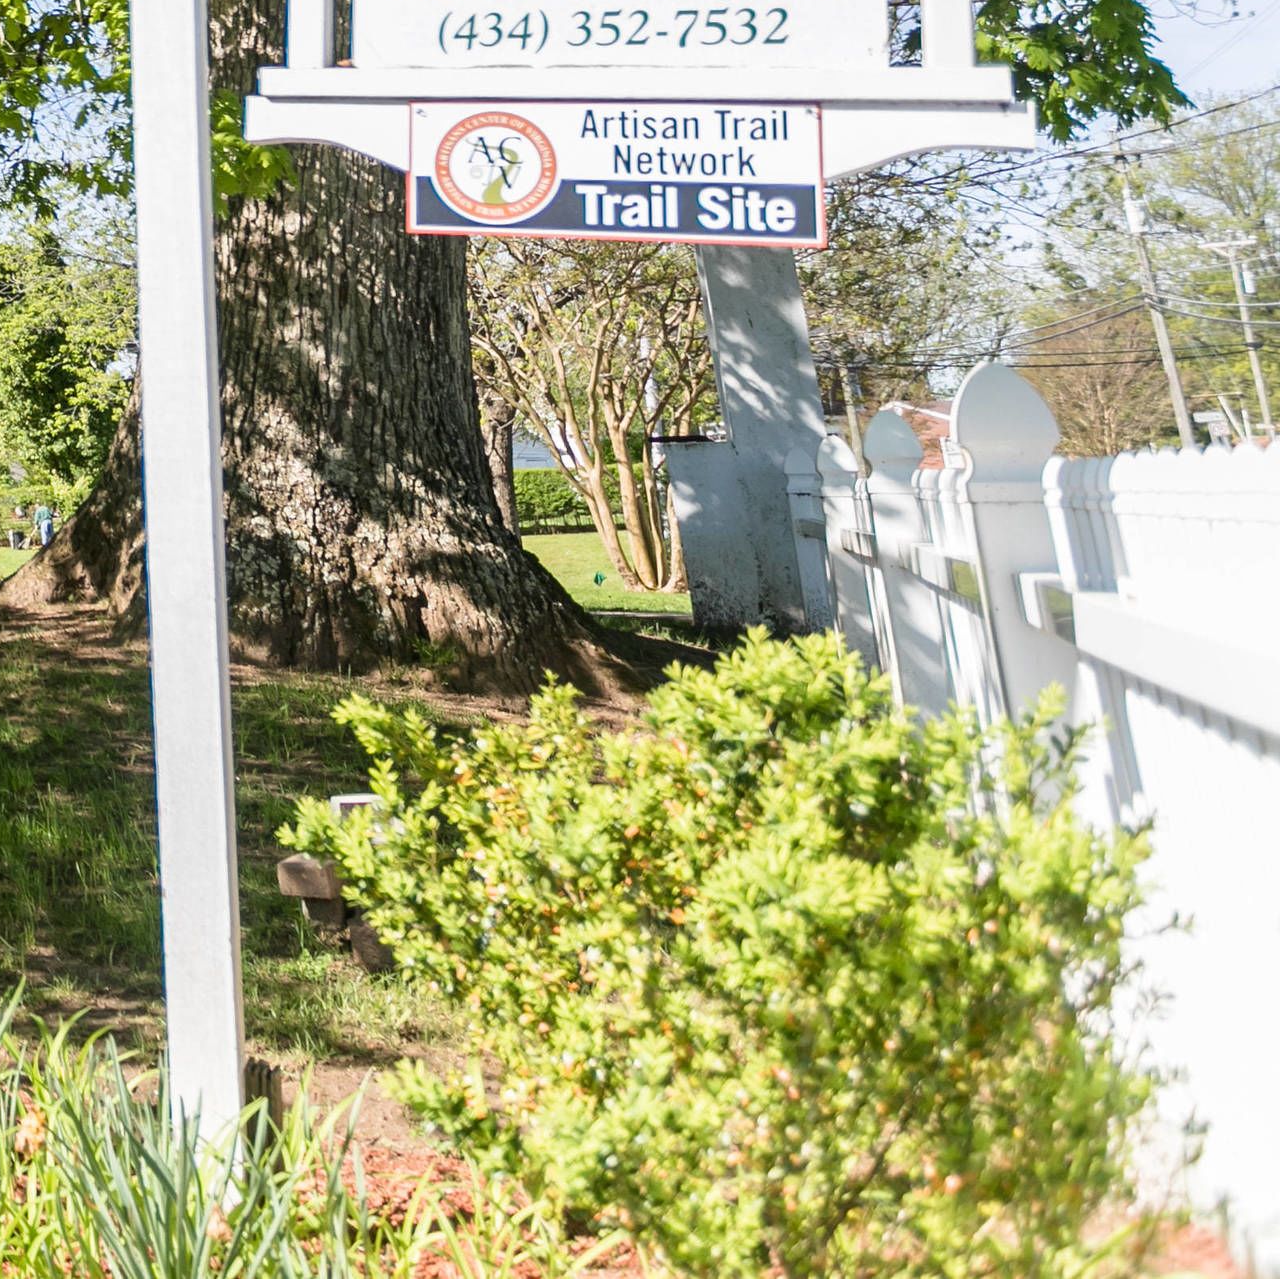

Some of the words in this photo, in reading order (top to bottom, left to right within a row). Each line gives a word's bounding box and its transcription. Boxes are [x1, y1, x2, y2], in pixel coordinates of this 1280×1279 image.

[437, 10, 550, 53] (434)
[567, 7, 789, 48] 352-7532
[580, 109, 700, 140] Artisan
[714, 109, 788, 141] Trail
[613, 144, 757, 177] Network
[575, 184, 679, 228] Trail
[697, 186, 796, 233] Site
